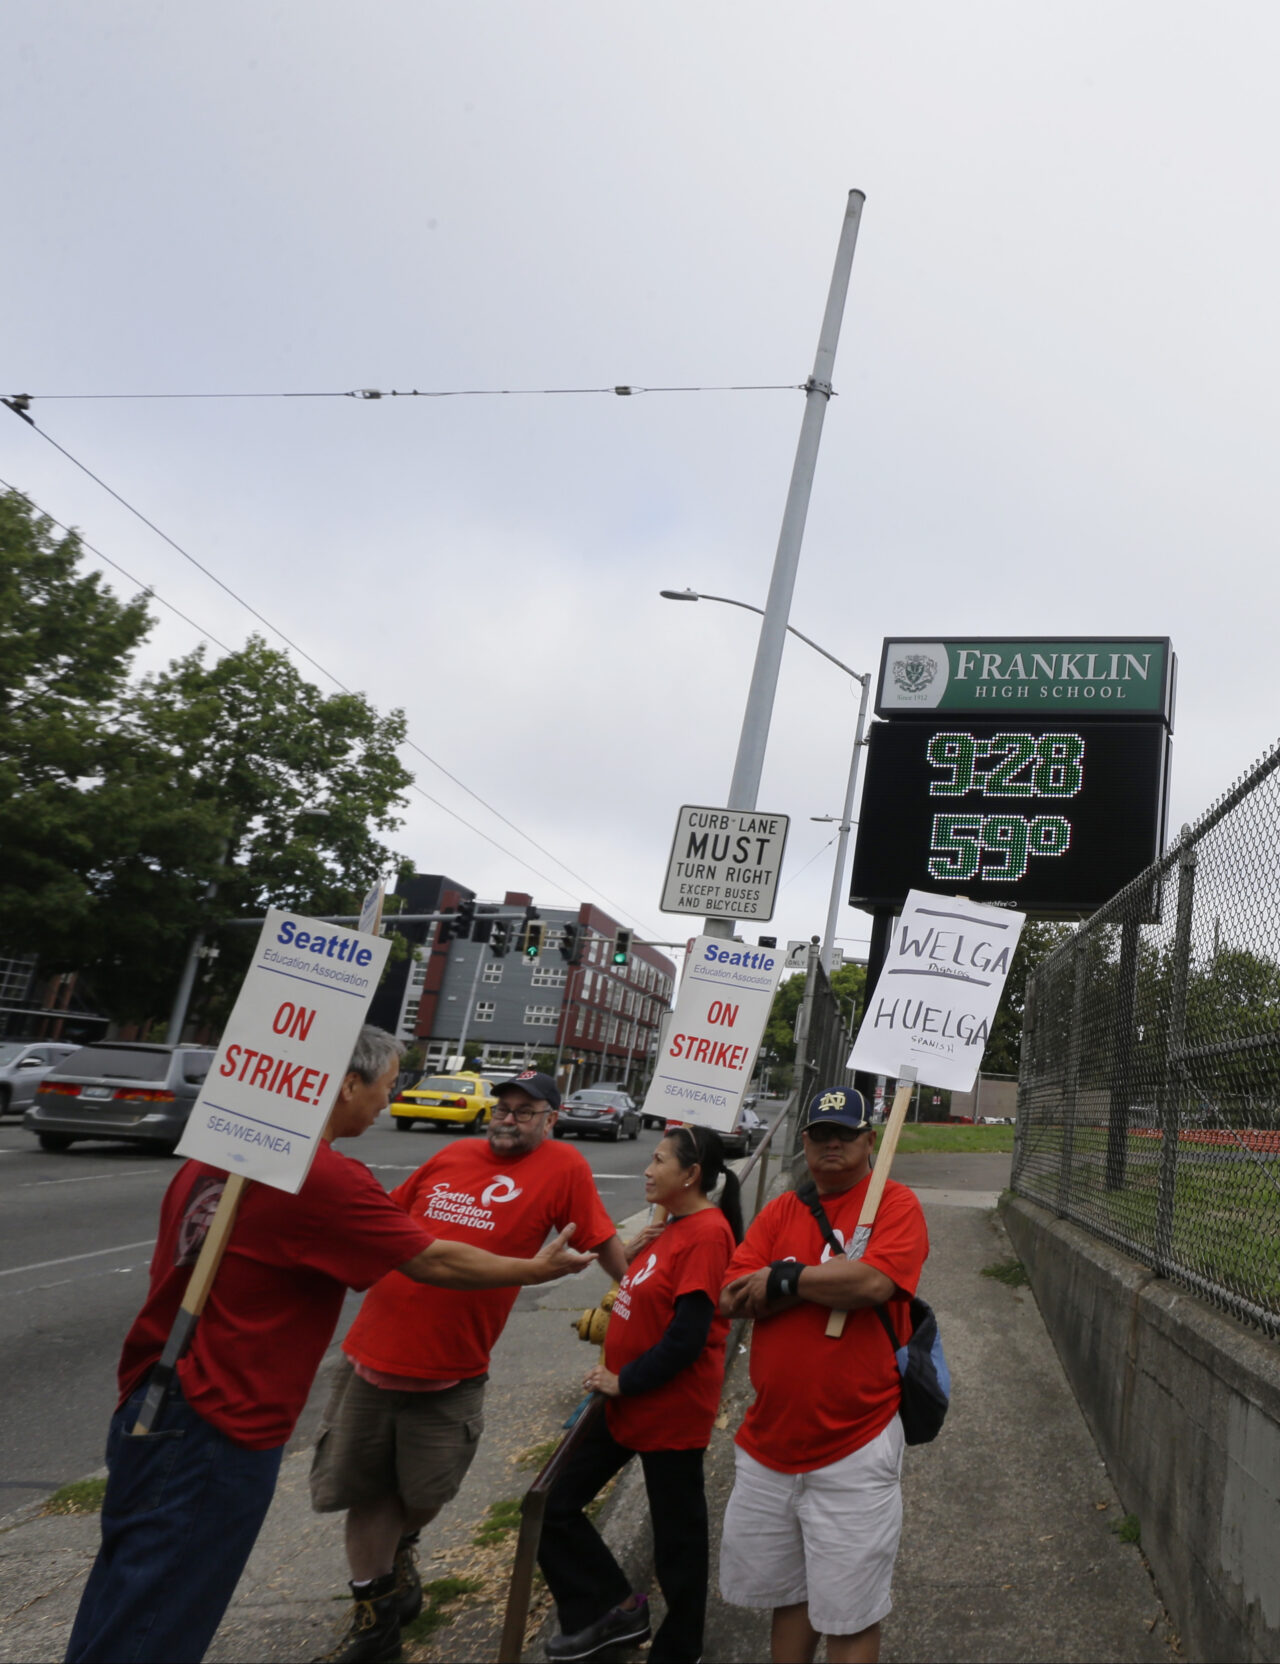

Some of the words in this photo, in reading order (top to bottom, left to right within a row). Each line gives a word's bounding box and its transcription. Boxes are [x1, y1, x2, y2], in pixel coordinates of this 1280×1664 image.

[954, 650, 1151, 681] FRANKLIN
[975, 686, 1029, 698] HIGH
[1040, 686, 1126, 699] SCHOOL
[927, 733, 1085, 798] 9:28
[689, 812, 729, 830] CURB
[738, 817, 778, 835] LANE
[686, 831, 770, 865] MUST
[676, 862, 717, 880] TURN
[725, 867, 772, 885] RIGHT
[678, 896, 700, 909] AND
[706, 899, 757, 913] BICYCLES
[680, 883, 720, 897] EXCEPT
[724, 887, 760, 901] BUSES
[277, 921, 372, 967] Seattle
[704, 944, 775, 971] Seattle
[899, 925, 1011, 975] WELGA
[263, 948, 310, 972] Education
[311, 963, 368, 988] Association
[694, 964, 732, 978] Education
[732, 971, 772, 985] Association
[272, 1002, 316, 1041] ON
[707, 1000, 739, 1028] ON
[874, 997, 988, 1046] HUELGA
[669, 1033, 749, 1071] STRIKE!
[911, 1035, 954, 1053] SPANISH
[219, 1044, 329, 1106] STRIKE!
[664, 1084, 727, 1107] SEA/WEA/NEA
[207, 1115, 291, 1155] SEA/WEA/NEA
[426, 1182, 475, 1205] Seattle
[423, 1207, 495, 1231] Association
[429, 1197, 492, 1219] Education
